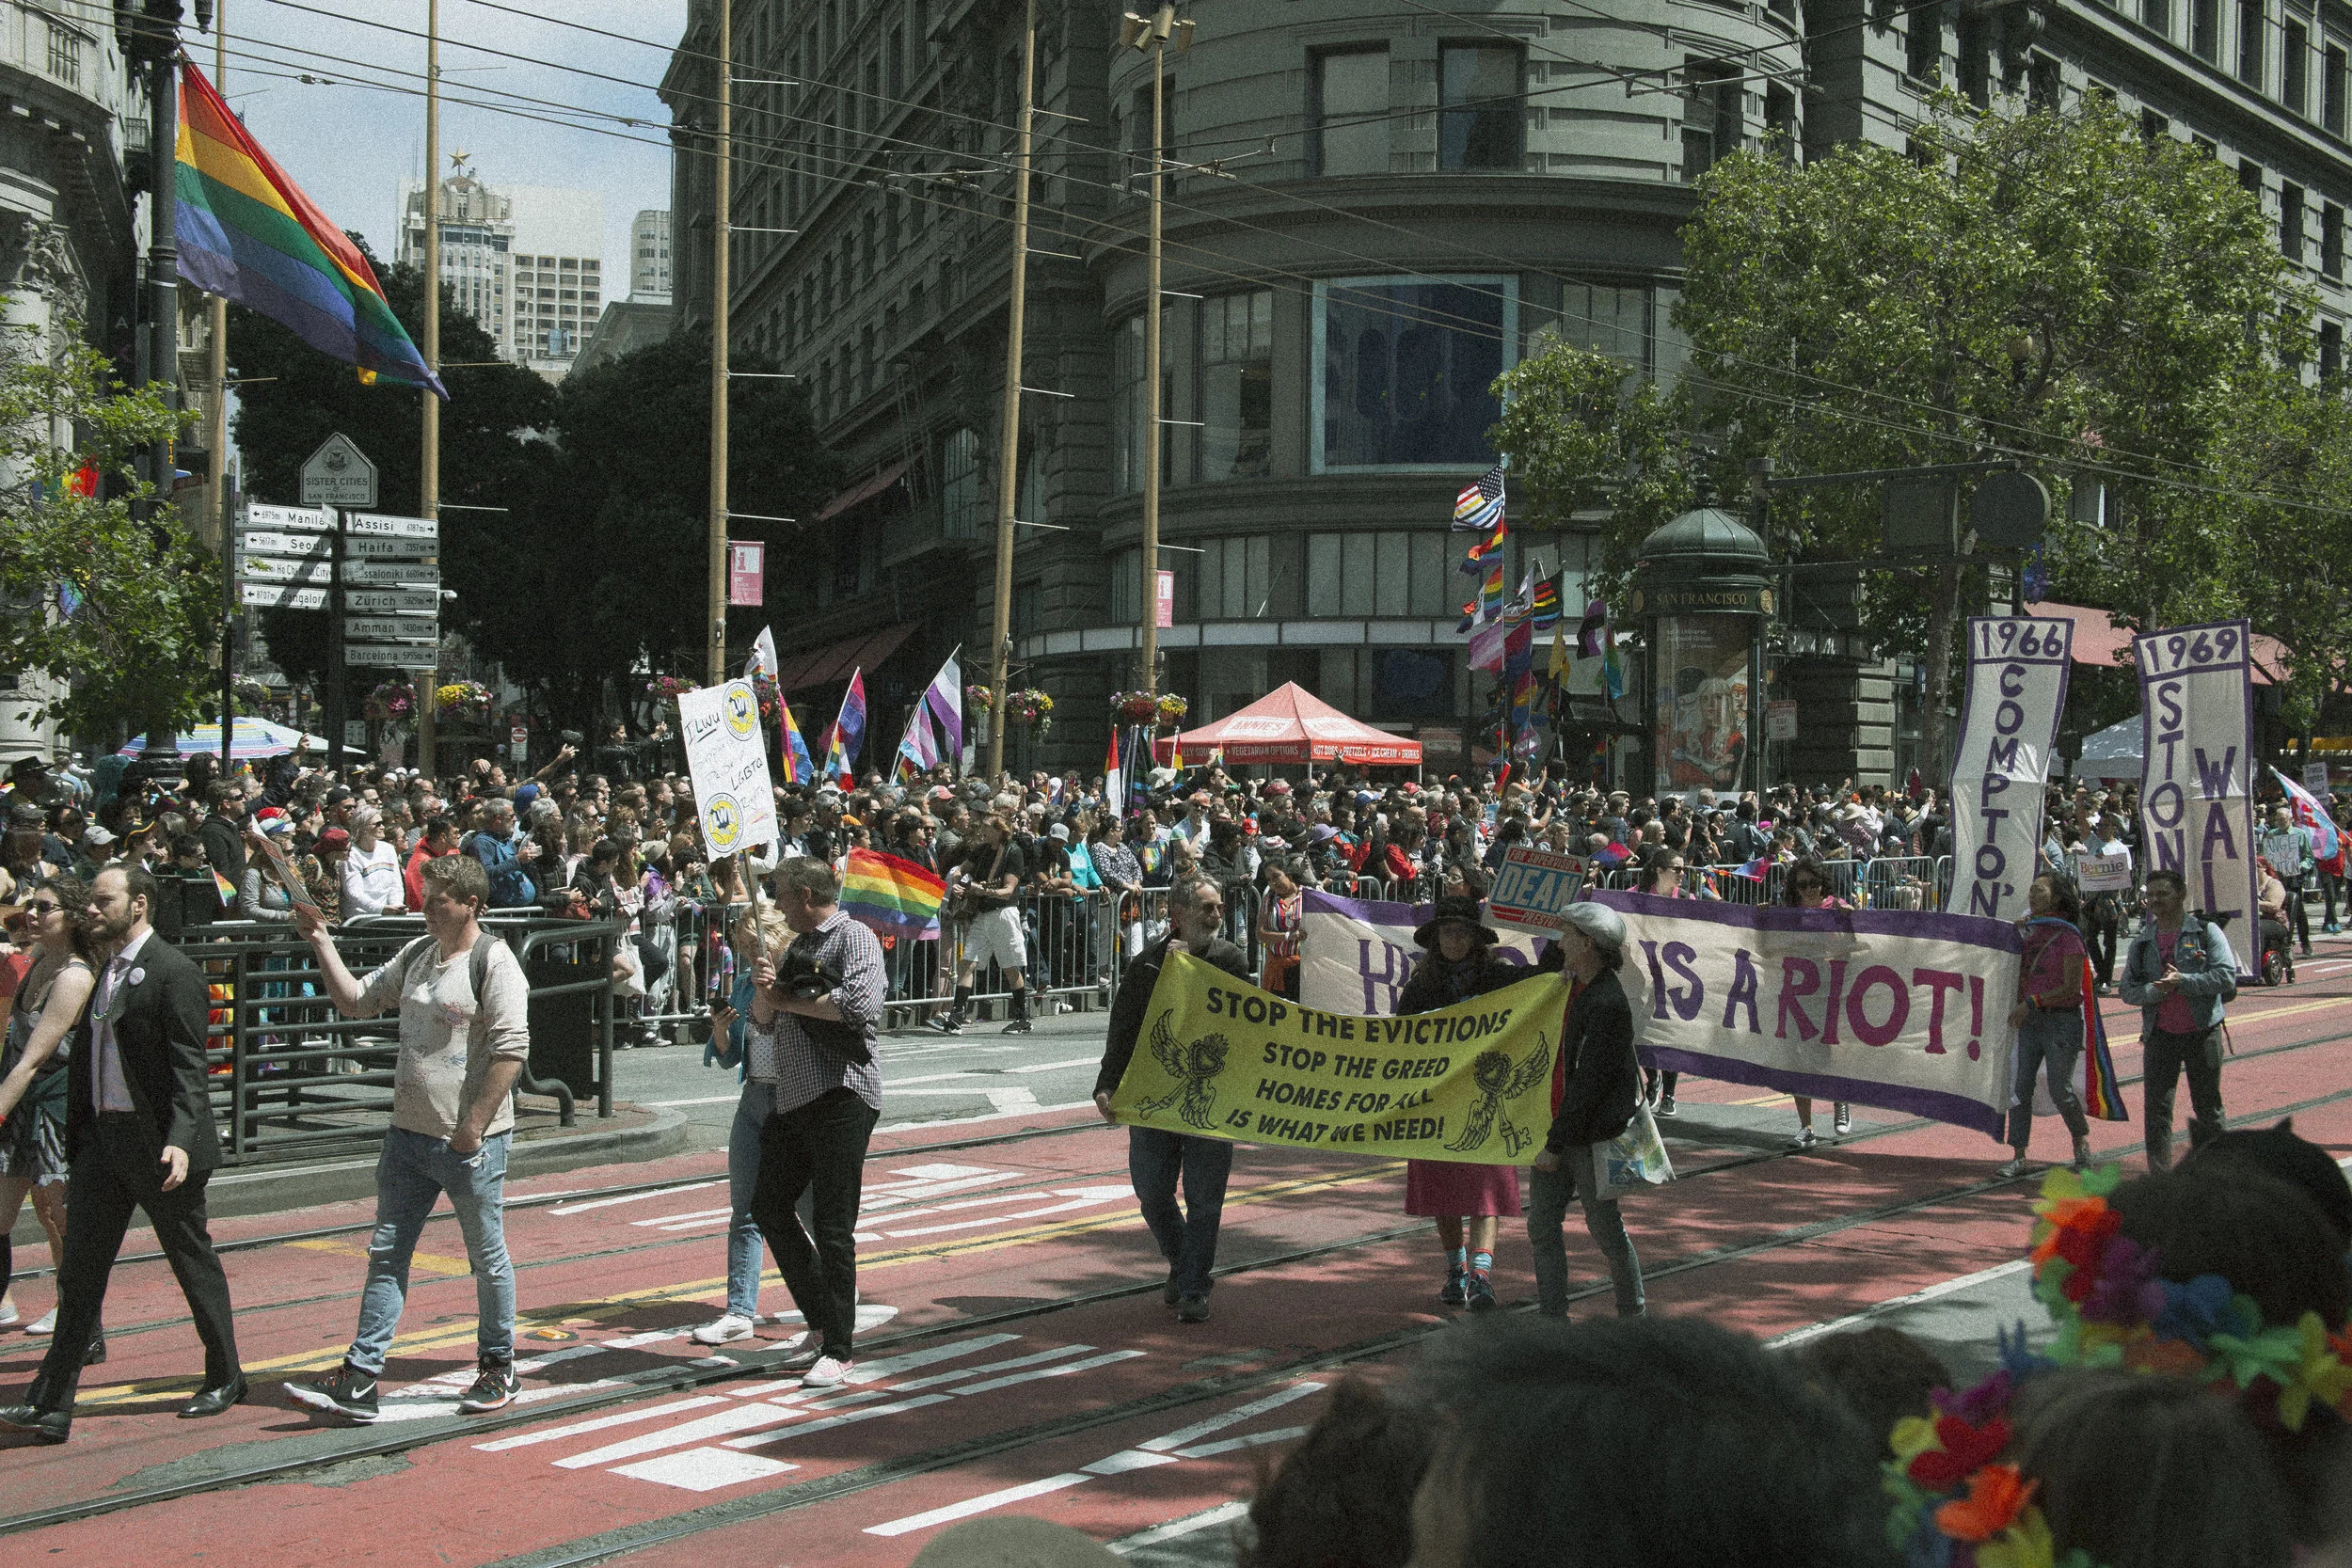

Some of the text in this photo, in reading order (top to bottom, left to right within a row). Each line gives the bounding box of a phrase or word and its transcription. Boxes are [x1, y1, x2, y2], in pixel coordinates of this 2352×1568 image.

[306, 477, 369, 486] SISTER CITIES
[288, 513, 325, 526] Manila
[355, 518, 394, 531] Assisi
[291, 538, 324, 552] Seoul
[358, 542, 393, 552] Haifa
[277, 564, 285, 575] Ho
[315, 566, 329, 578] City
[364, 569, 404, 579] ssaloniki
[281, 592, 327, 606] Bangalore
[355, 595, 396, 607] Zürich
[1657, 593, 1748, 606] SAN FRANCISCO
[353, 622, 395, 633] Amman
[1981, 622, 2063, 657] 1966
[350, 649, 398, 660] Barcelona
[2145, 628, 2239, 673] 1969
[685, 712, 720, 746] ILWU
[1232, 745, 1269, 756] VEGETARIAN
[1270, 744, 1298, 755] OPTIONS
[1313, 744, 1420, 759] HOT DOGS PRETZELS ICE CREAM DRINKS
[730, 757, 763, 791] LGBTQ
[2149, 682, 2185, 873] STON
[1508, 848, 1579, 871] FOR SUPERVISOR
[2195, 746, 2243, 973] WAL
[2080, 860, 2124, 875] Bernie
[1494, 864, 1579, 912] DEAN
[1638, 940, 1704, 1022] IS
[1722, 948, 1762, 1035] A
[1774, 957, 1985, 1062] RIOT!
[1206, 987, 1513, 1046] STOP THE EVICTIONS
[1263, 1041, 1451, 1081] STOP THE GREED
[1255, 1078, 1435, 1114] HOMES FOR ALL
[1225, 1108, 1445, 1143] IS WHAT WE NEED!
